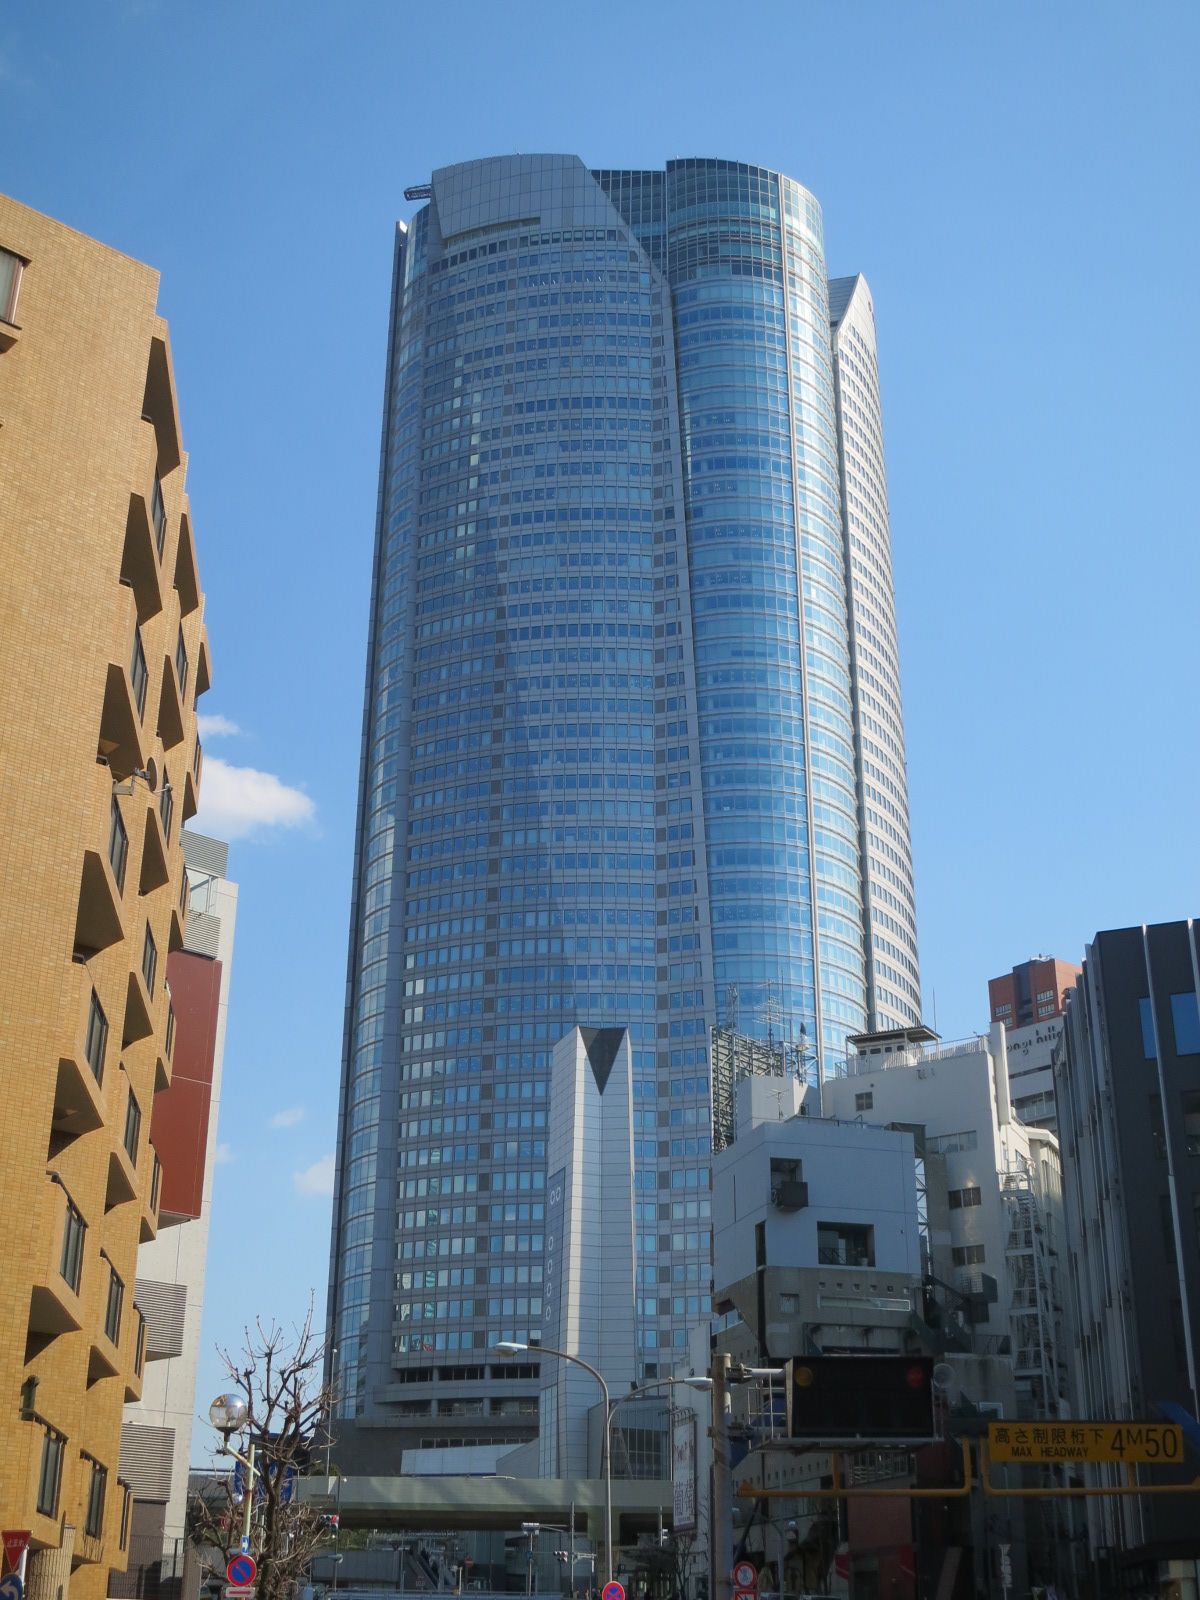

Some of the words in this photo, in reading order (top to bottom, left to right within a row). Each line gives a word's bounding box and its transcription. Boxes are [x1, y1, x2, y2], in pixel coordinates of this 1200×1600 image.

[996, 1428, 1104, 1445] 高さ制限桁下
[1111, 1428, 1177, 1457] 4M50
[1011, 1447, 1033, 1457] MAX
[1041, 1447, 1089, 1457] HEADWAY
